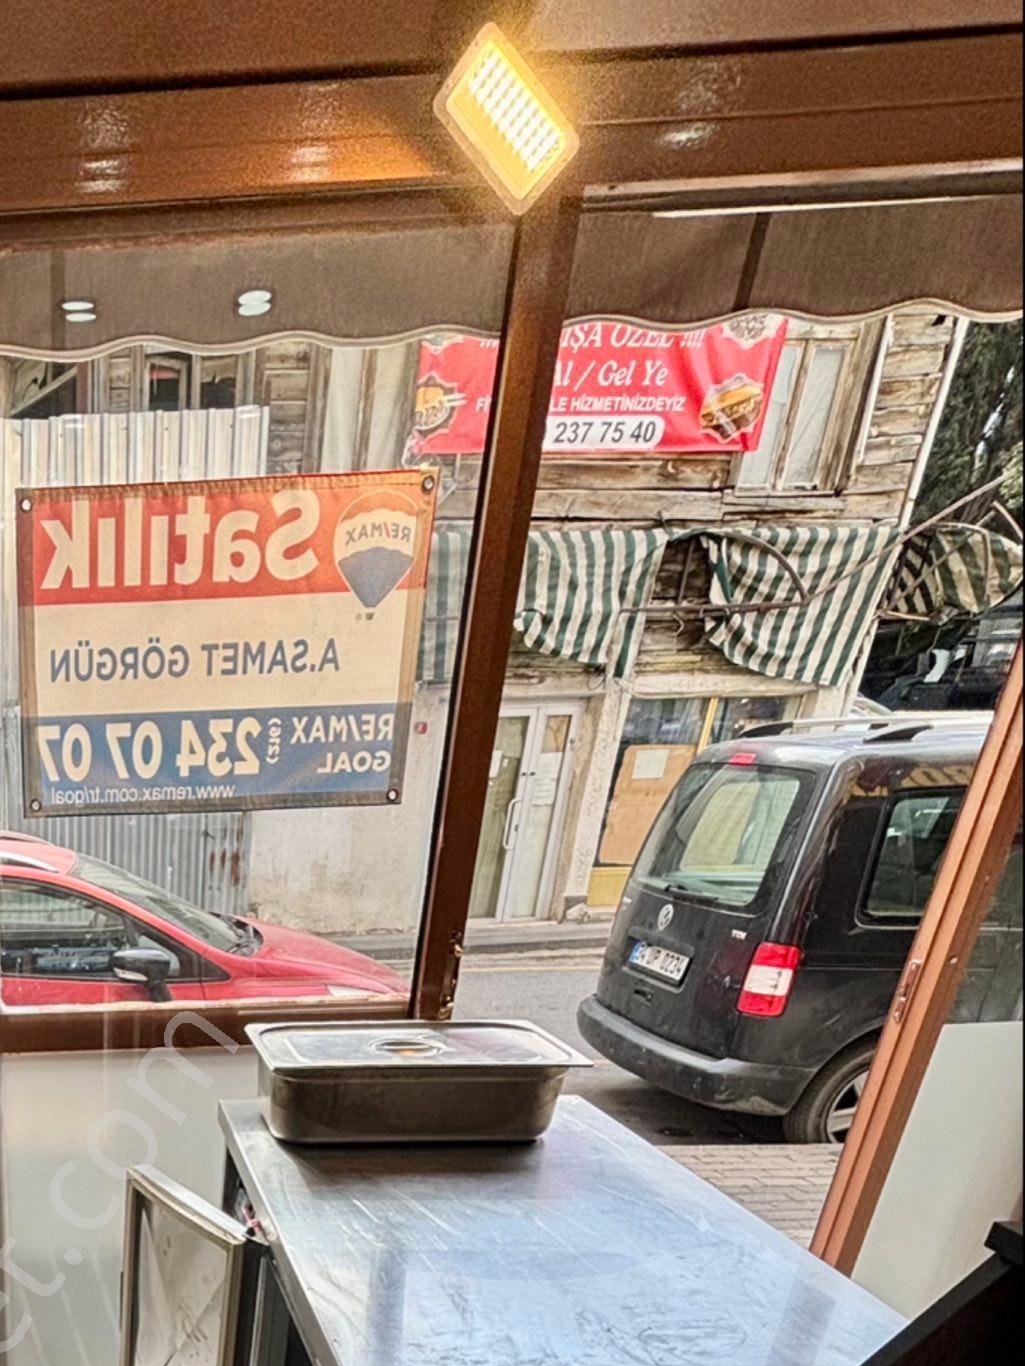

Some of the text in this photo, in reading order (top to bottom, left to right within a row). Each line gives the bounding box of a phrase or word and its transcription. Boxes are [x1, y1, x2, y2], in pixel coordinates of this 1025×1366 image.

[574, 361, 596, 392] /
[597, 360, 637, 386] Gel
[641, 359, 669, 386] Ye
[570, 393, 687, 412] HİZMETİNİZDEYİZ
[553, 420, 657, 444] 237 75 40
